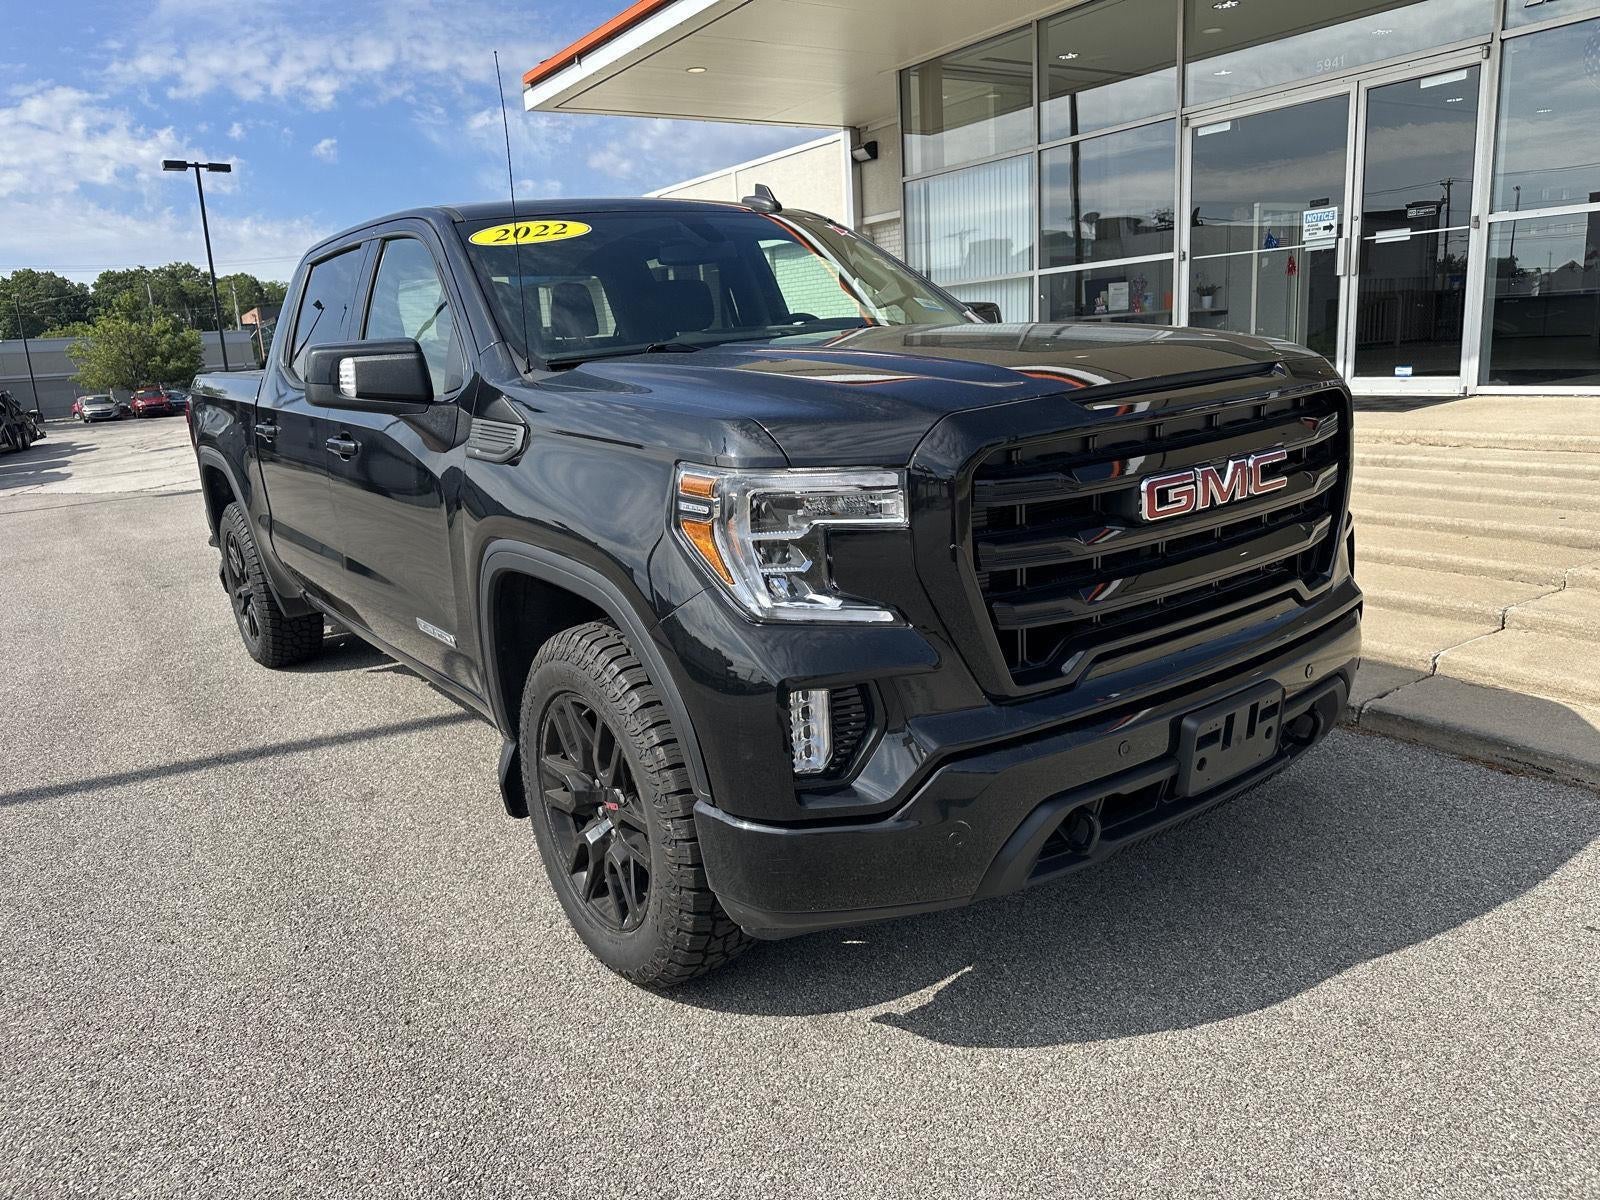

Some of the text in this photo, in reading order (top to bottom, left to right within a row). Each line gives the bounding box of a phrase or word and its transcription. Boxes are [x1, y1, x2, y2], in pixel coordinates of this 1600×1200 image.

[1316, 55, 1345, 73] 5941
[1306, 211, 1334, 223] NOTICE
[493, 223, 568, 243] 2022
[1140, 449, 1288, 521] GMC
